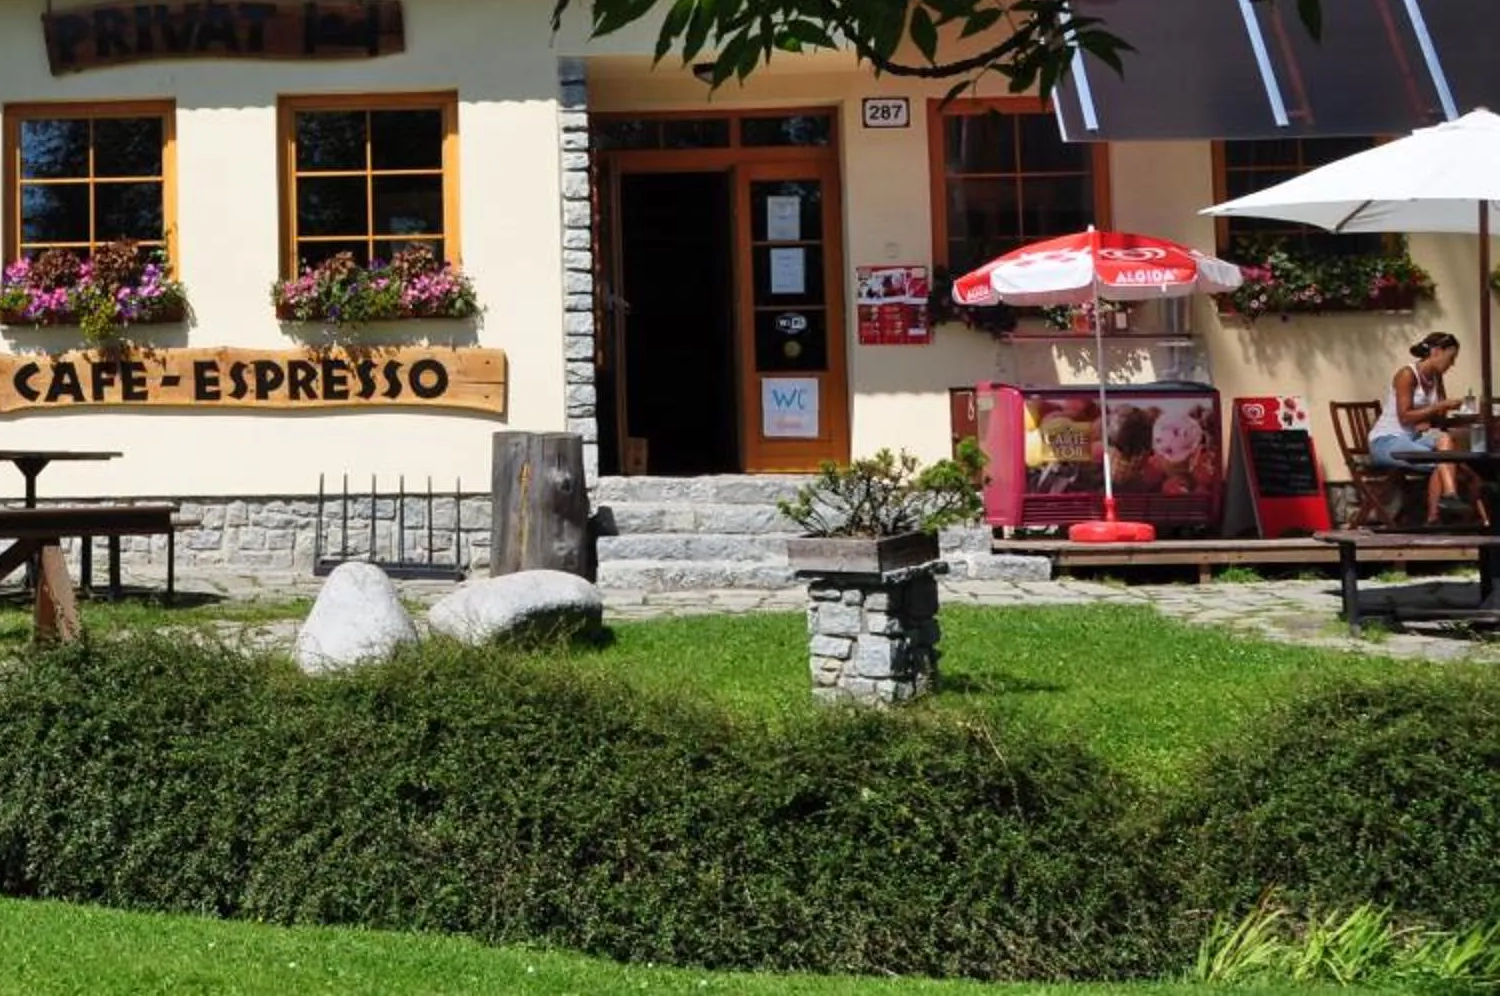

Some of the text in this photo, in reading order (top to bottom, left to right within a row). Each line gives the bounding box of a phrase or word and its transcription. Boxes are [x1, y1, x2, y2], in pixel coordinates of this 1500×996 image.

[56, 1, 277, 63] PRIVAT
[869, 105, 902, 120] 287
[1115, 268, 1176, 284] ALGIDA
[771, 387, 808, 410] WC
